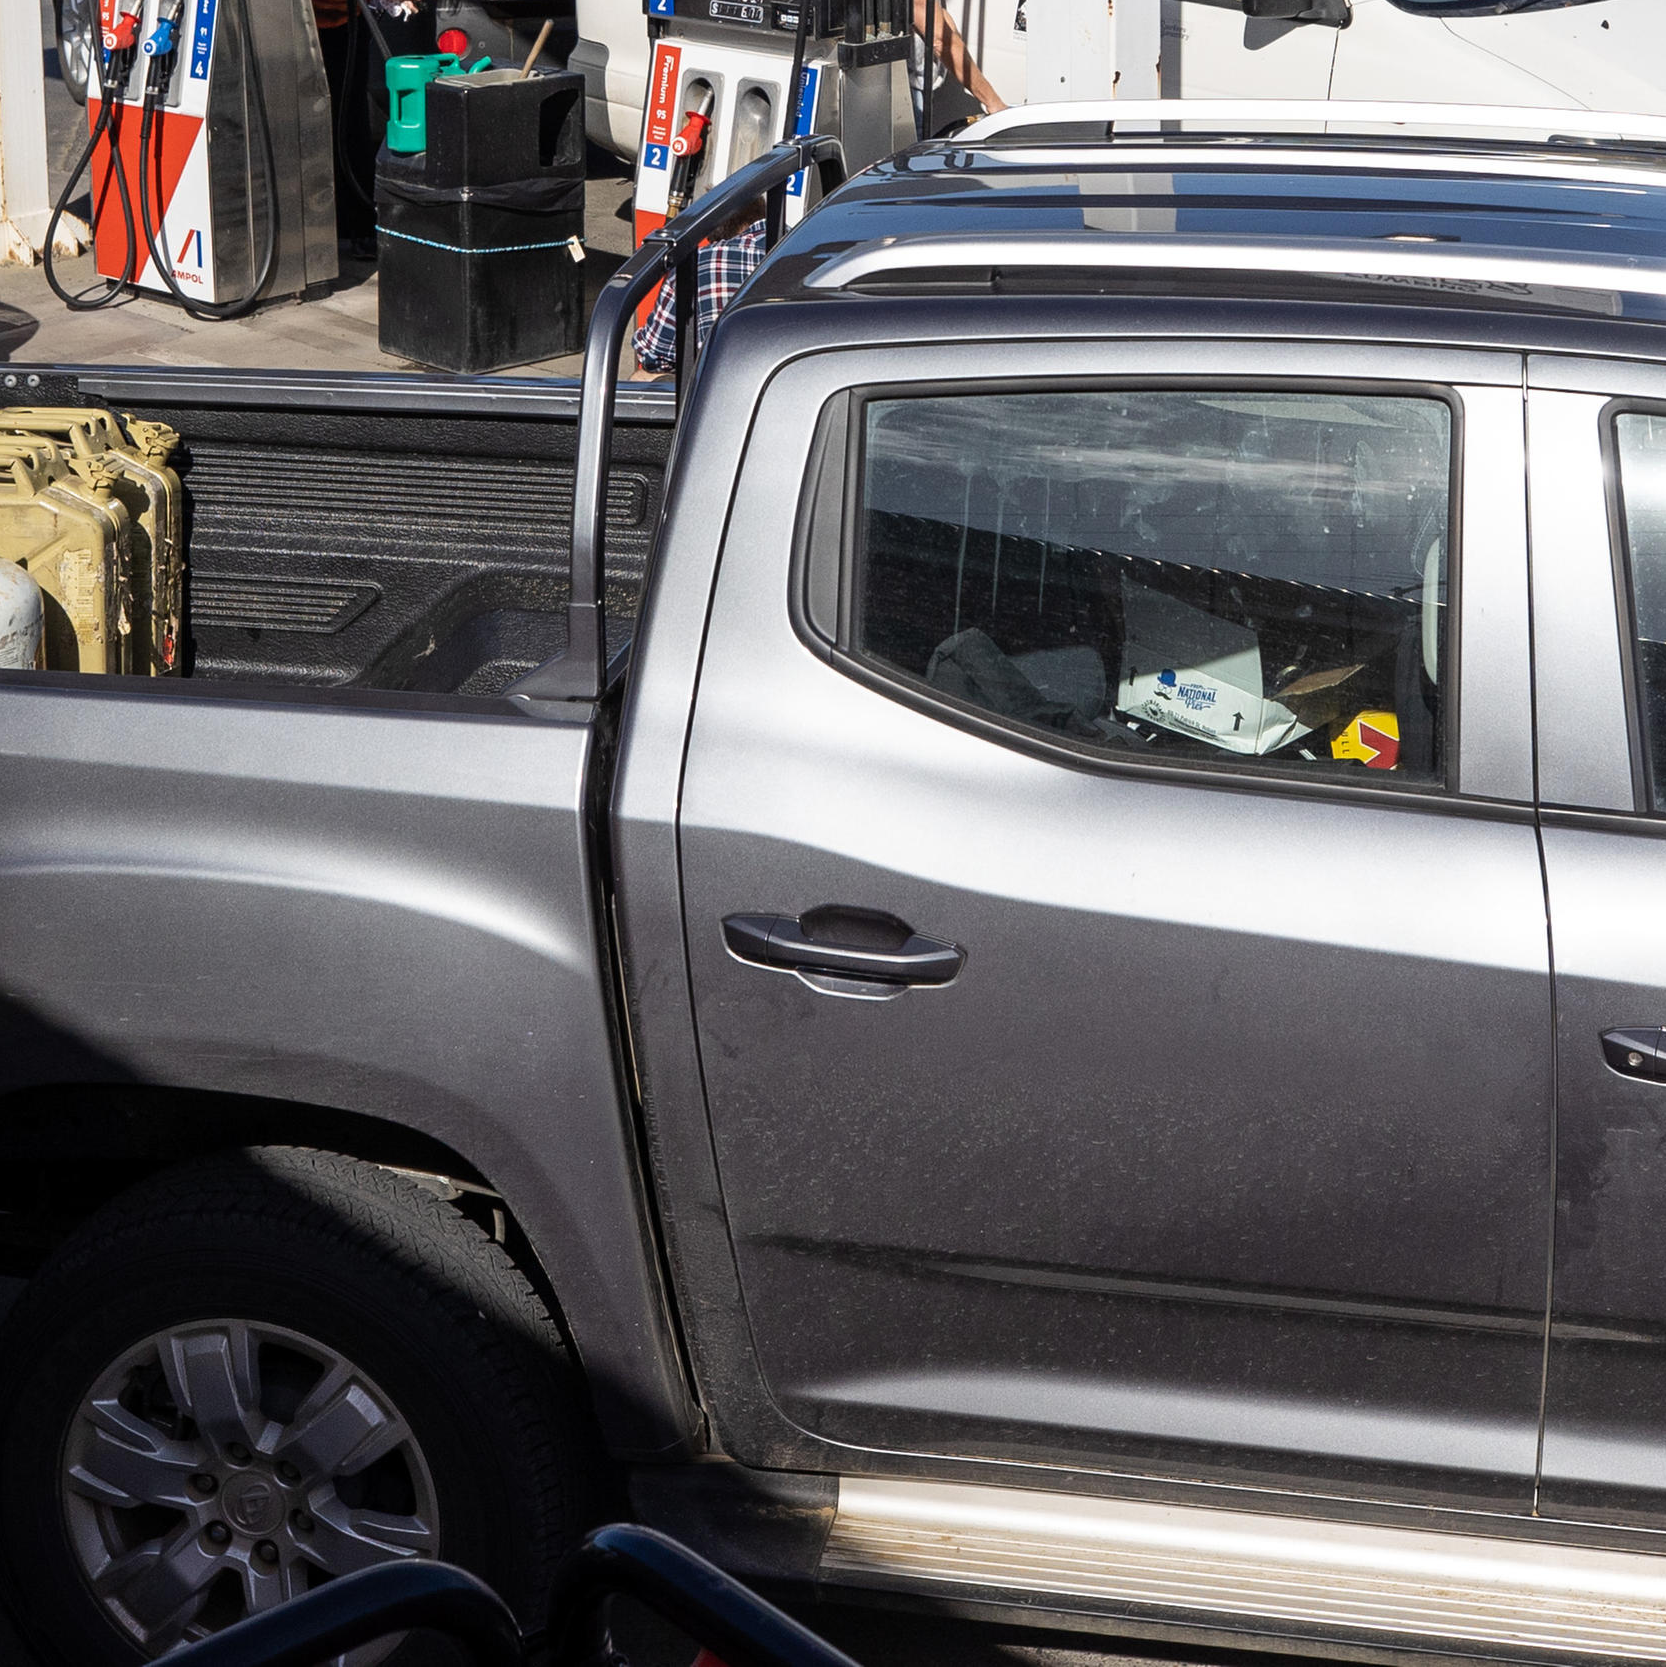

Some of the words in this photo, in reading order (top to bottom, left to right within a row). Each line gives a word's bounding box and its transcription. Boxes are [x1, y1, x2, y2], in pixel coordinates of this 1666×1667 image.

[194, 60, 204, 77] 4
[658, 54, 673, 105] Premium
[795, 71, 807, 119] Unleaded
[656, 108, 667, 121] 95
[650, 147, 661, 166] 2
[786, 174, 796, 192] 2
[171, 269, 204, 284] AMPOL
[1176, 685, 1219, 703] NATIONAL
